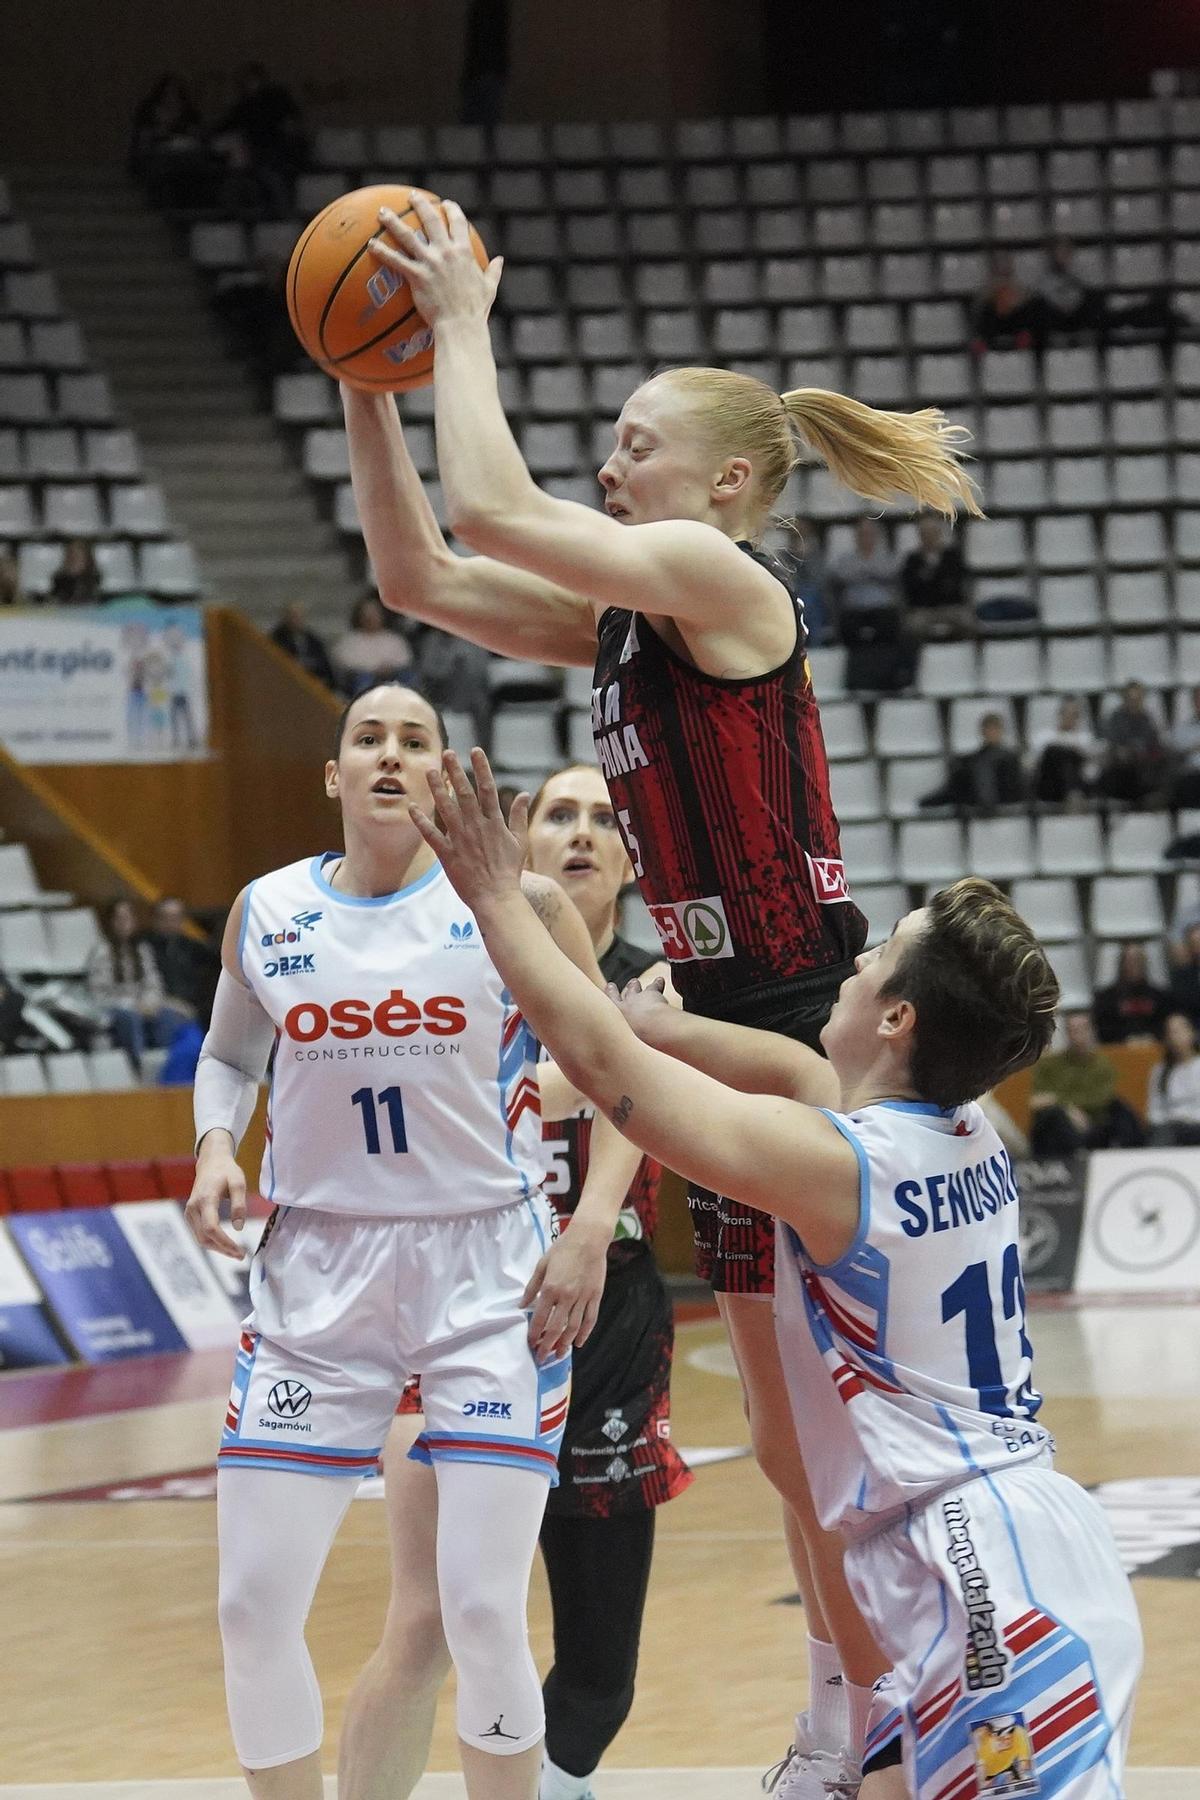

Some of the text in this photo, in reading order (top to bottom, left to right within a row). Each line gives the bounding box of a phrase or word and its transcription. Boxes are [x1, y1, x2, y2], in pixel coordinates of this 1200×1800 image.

[262, 928, 301, 946] ardoi
[279, 954, 314, 971] BZK
[295, 1043, 460, 1061] CONSTRUCCIÓN
[351, 1086, 408, 1154] 11
[477, 1401, 512, 1416] BZK
[259, 1418, 312, 1433] Sagamóvil
